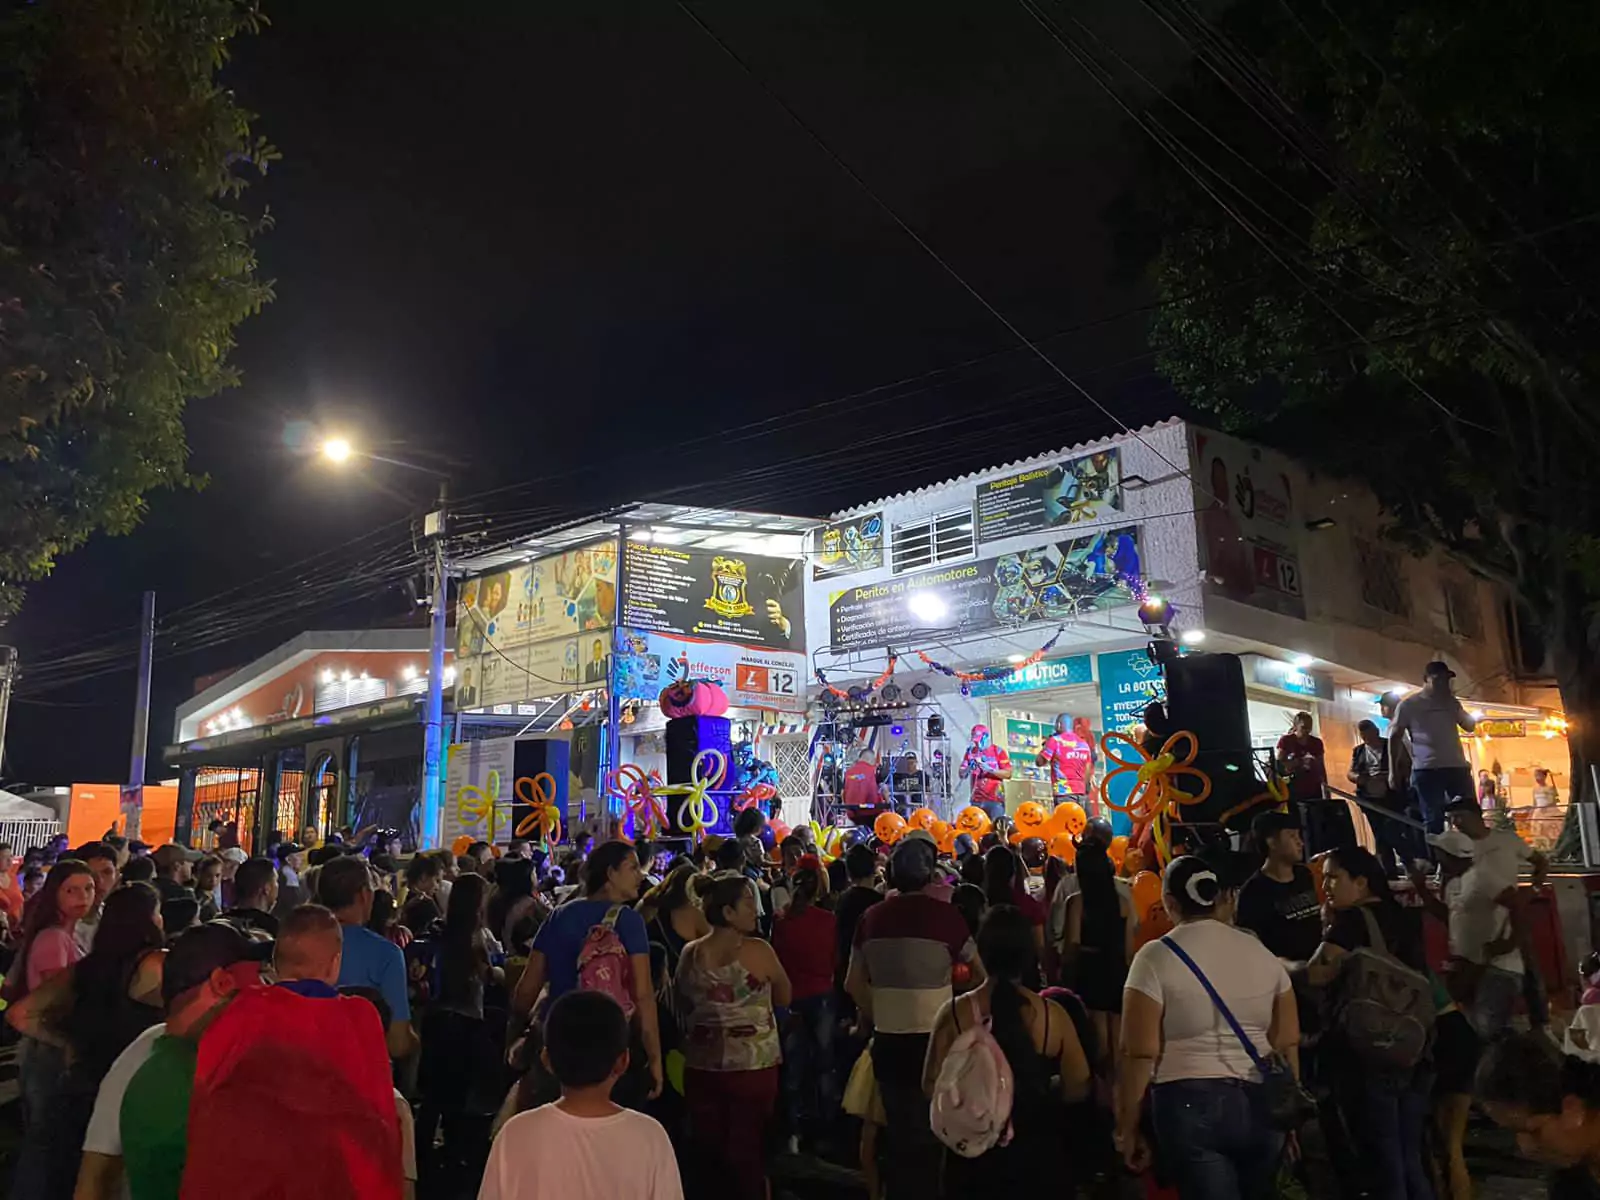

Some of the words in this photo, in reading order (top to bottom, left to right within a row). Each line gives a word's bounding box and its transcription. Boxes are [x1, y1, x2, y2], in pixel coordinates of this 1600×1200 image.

[855, 586, 890, 601] Peritos
[892, 582, 905, 593] en
[907, 566, 978, 590] Automotores
[1280, 563, 1297, 591] 12
[841, 630, 877, 642] Certificados
[1025, 663, 1068, 682] BOTICA
[772, 673, 793, 693] 12
[1119, 682, 1131, 693] LA
